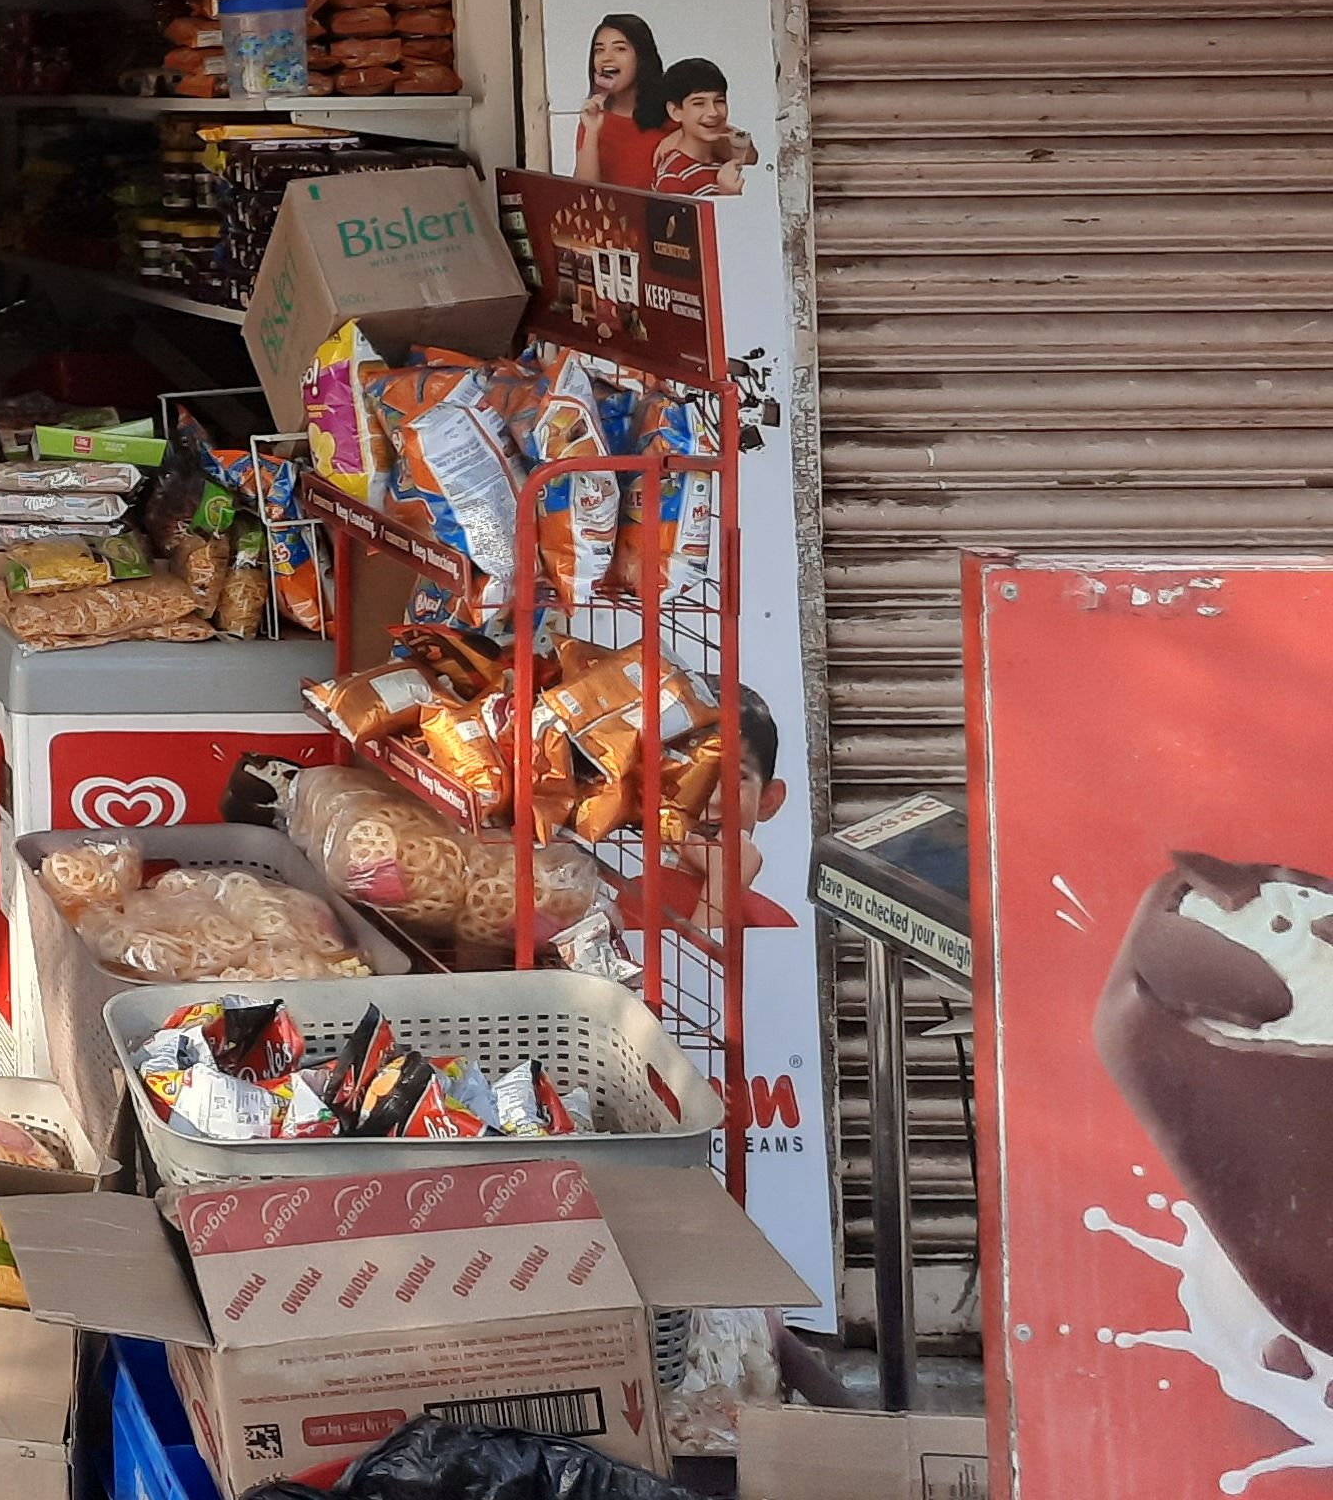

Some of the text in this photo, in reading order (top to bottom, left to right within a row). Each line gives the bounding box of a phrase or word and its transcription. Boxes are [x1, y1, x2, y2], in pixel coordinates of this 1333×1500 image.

[336, 201, 476, 258] Bisleri
[644, 283, 671, 312] KEEP
[817, 867, 972, 969] Have you checked your weigh
[266, 1186, 311, 1245] Colgate
[336, 1179, 383, 1238] Colgate
[409, 1172, 455, 1230] Colgate
[482, 1167, 528, 1224] Colgate
[191, 1194, 239, 1253] Colgate
[337, 1260, 380, 1310] PROMO
[395, 1254, 437, 1304] PROMO
[452, 1249, 494, 1299] PROMO
[508, 1244, 550, 1293] PROMO
[566, 1240, 607, 1288] PROMO
[224, 1271, 267, 1322] PROMO
[281, 1266, 324, 1316] PROMO
